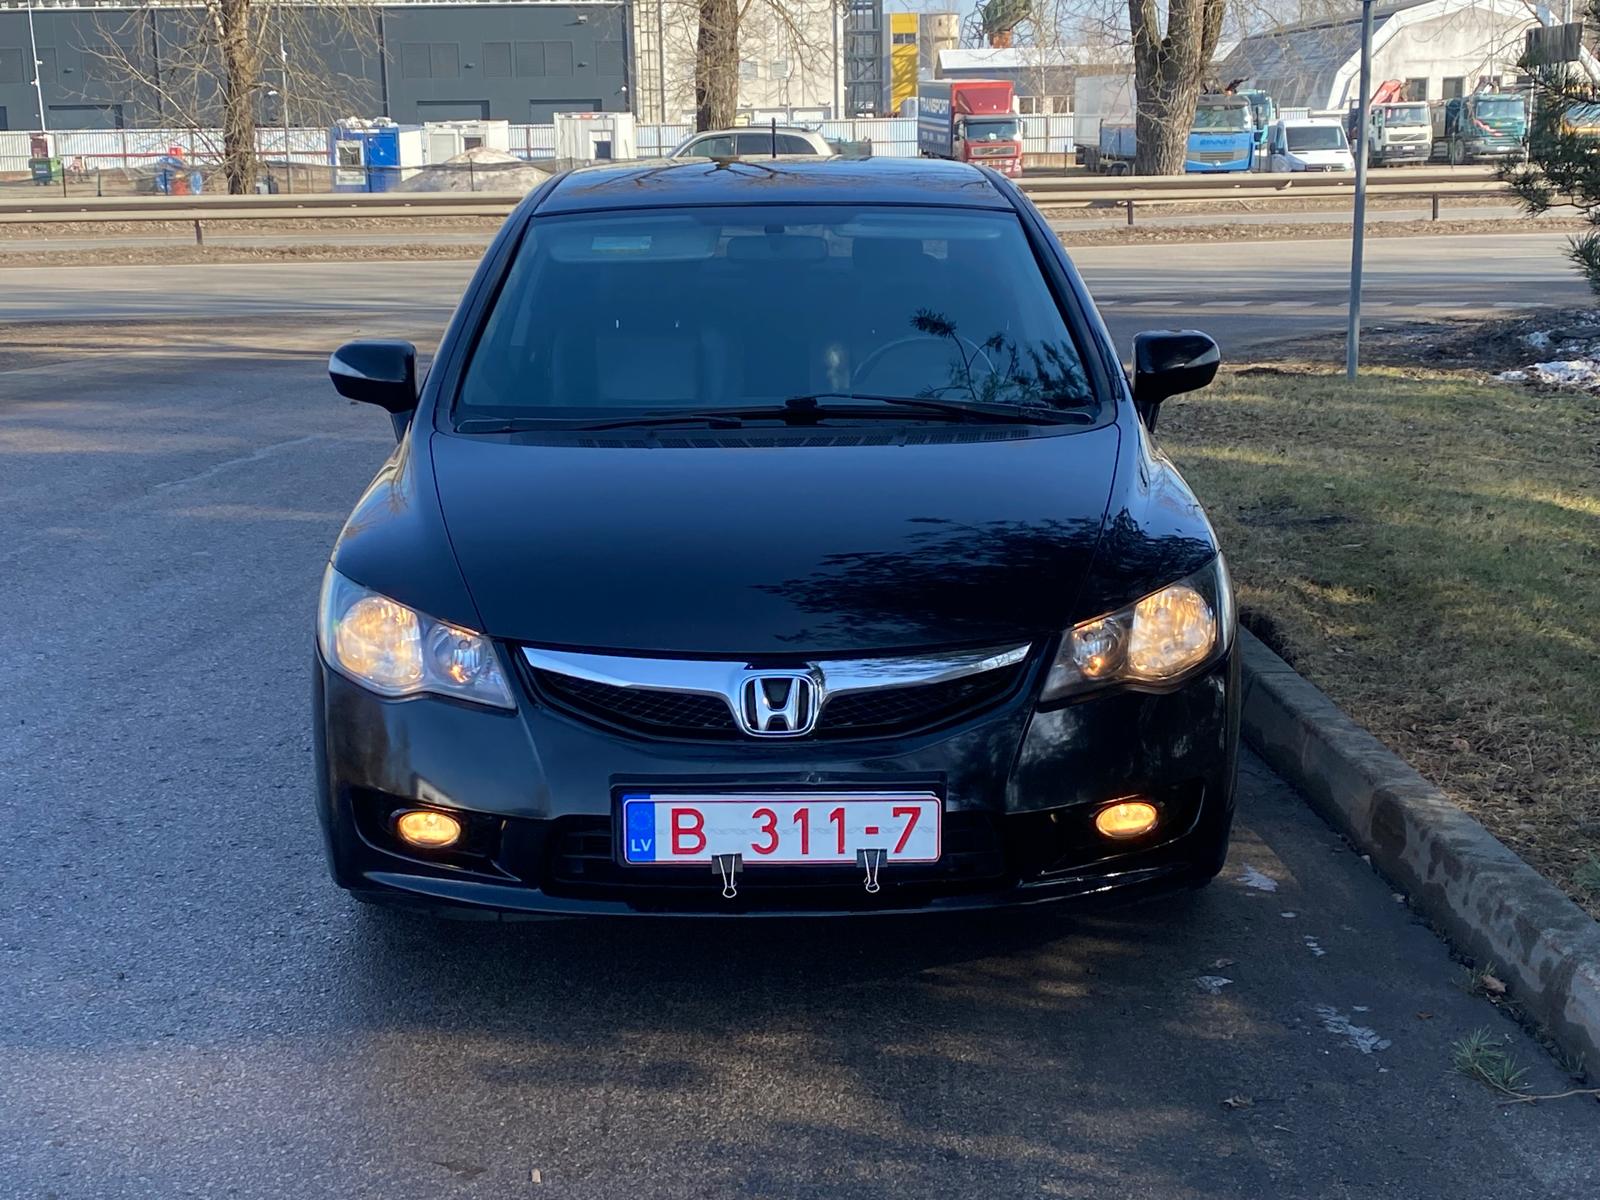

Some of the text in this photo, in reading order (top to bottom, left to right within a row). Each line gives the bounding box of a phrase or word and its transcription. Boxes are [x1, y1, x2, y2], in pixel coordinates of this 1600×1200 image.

[631, 838, 652, 852] LV
[671, 806, 922, 855] B 311-7
